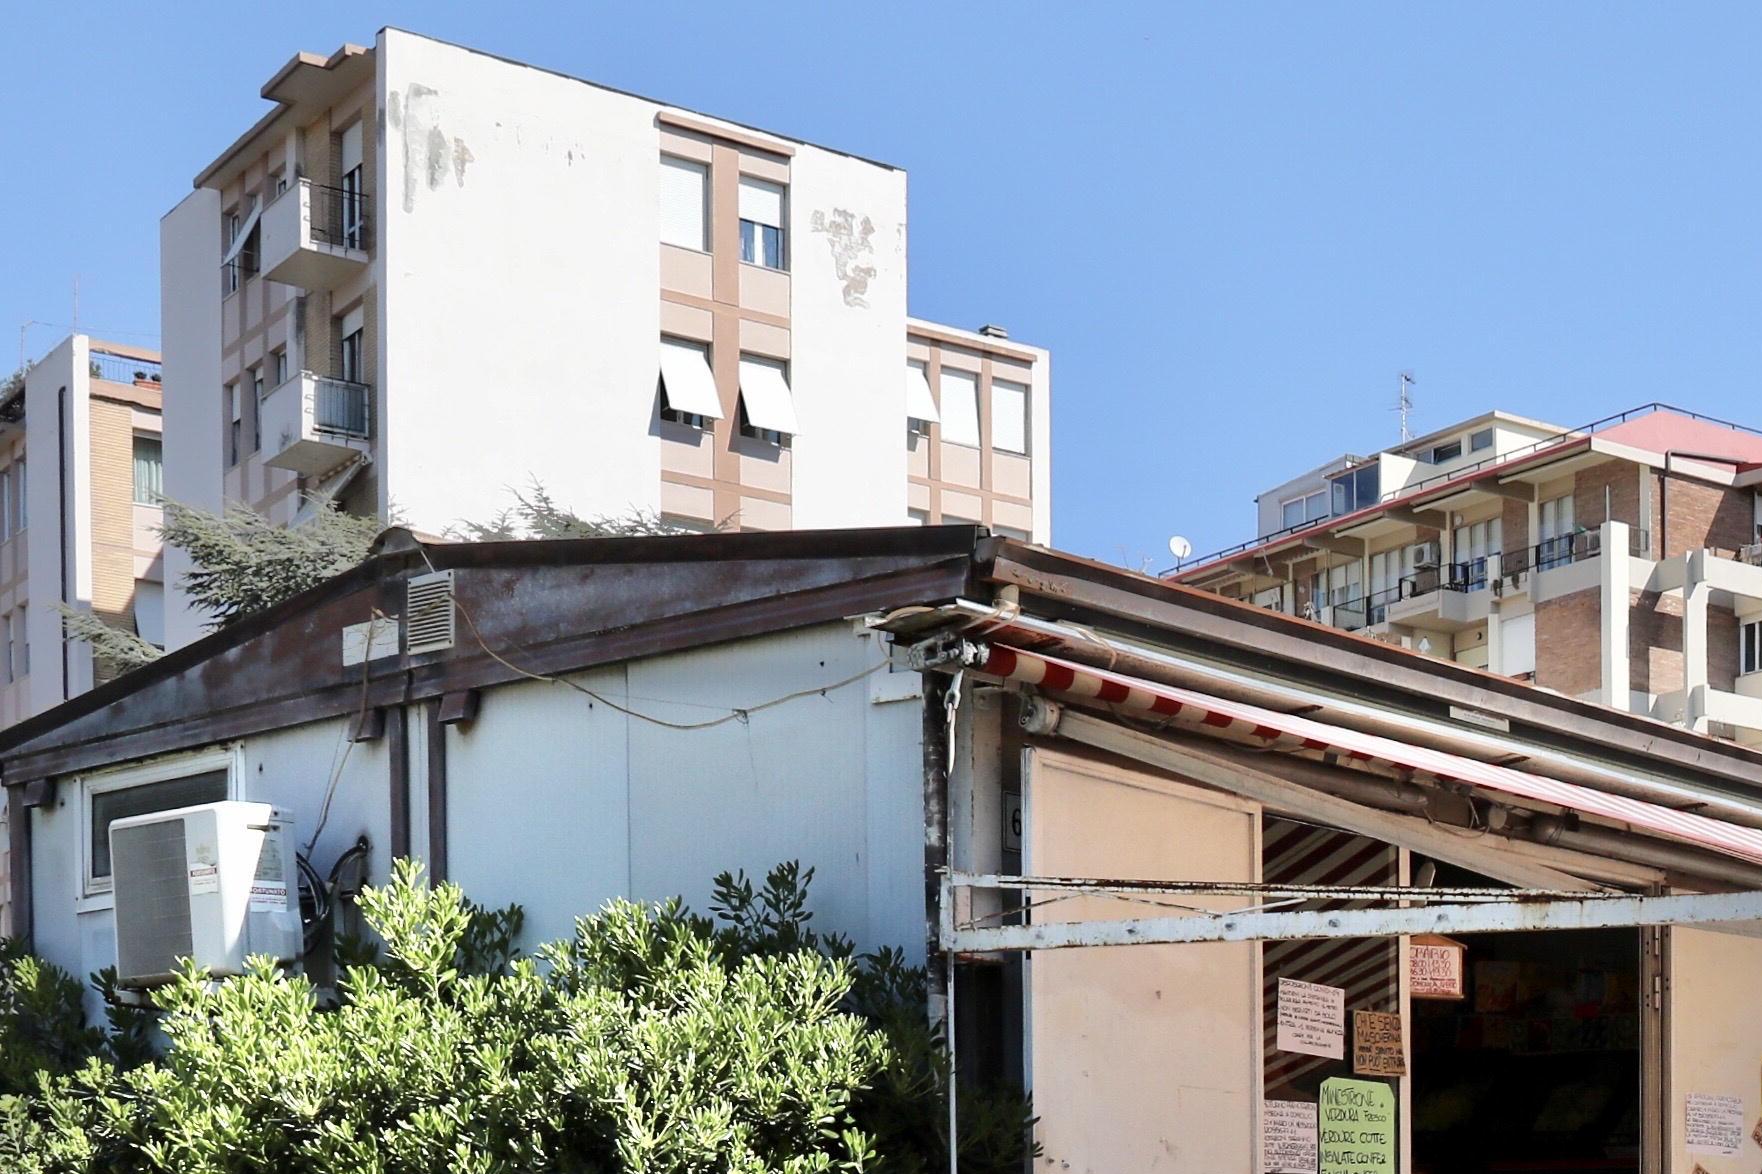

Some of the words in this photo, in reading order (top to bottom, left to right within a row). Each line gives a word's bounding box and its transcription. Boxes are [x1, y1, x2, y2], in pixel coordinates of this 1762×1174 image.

[1322, 1085, 1375, 1108] MINESTRONE
[1325, 1107, 1360, 1122] VERDURA
[1320, 1128, 1356, 1144] VERDURE
[1360, 1132, 1387, 1145] COTTE
